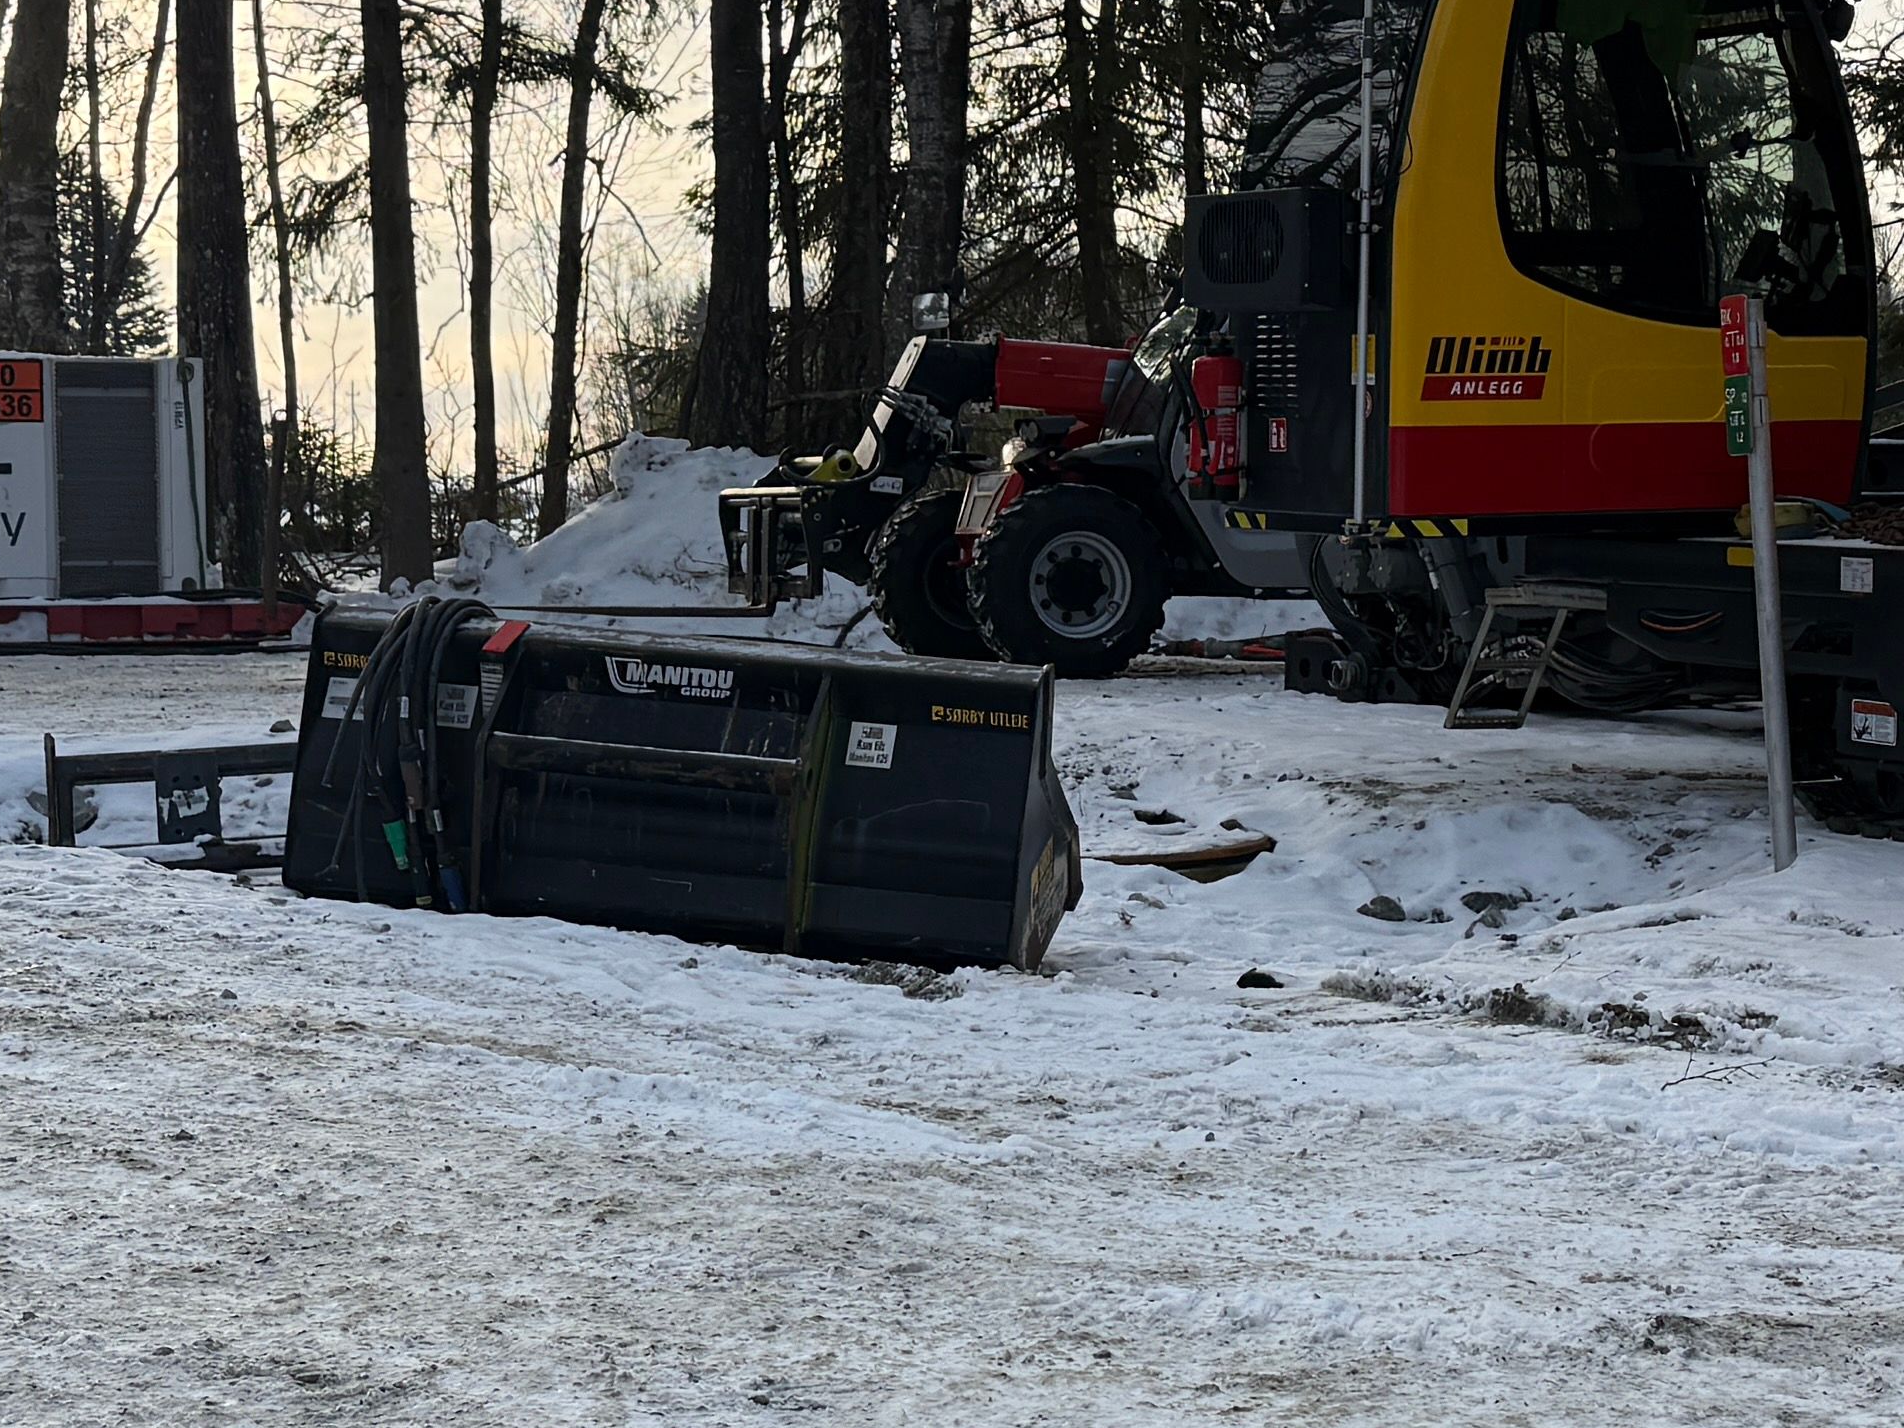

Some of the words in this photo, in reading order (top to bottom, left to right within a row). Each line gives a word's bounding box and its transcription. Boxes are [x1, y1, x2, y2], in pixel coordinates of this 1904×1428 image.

[1450, 381, 1524, 395] ANLEGG
[625, 662, 734, 689] MANITOU
[680, 687, 731, 699] GROUP
[946, 707, 985, 725] SØRBY
